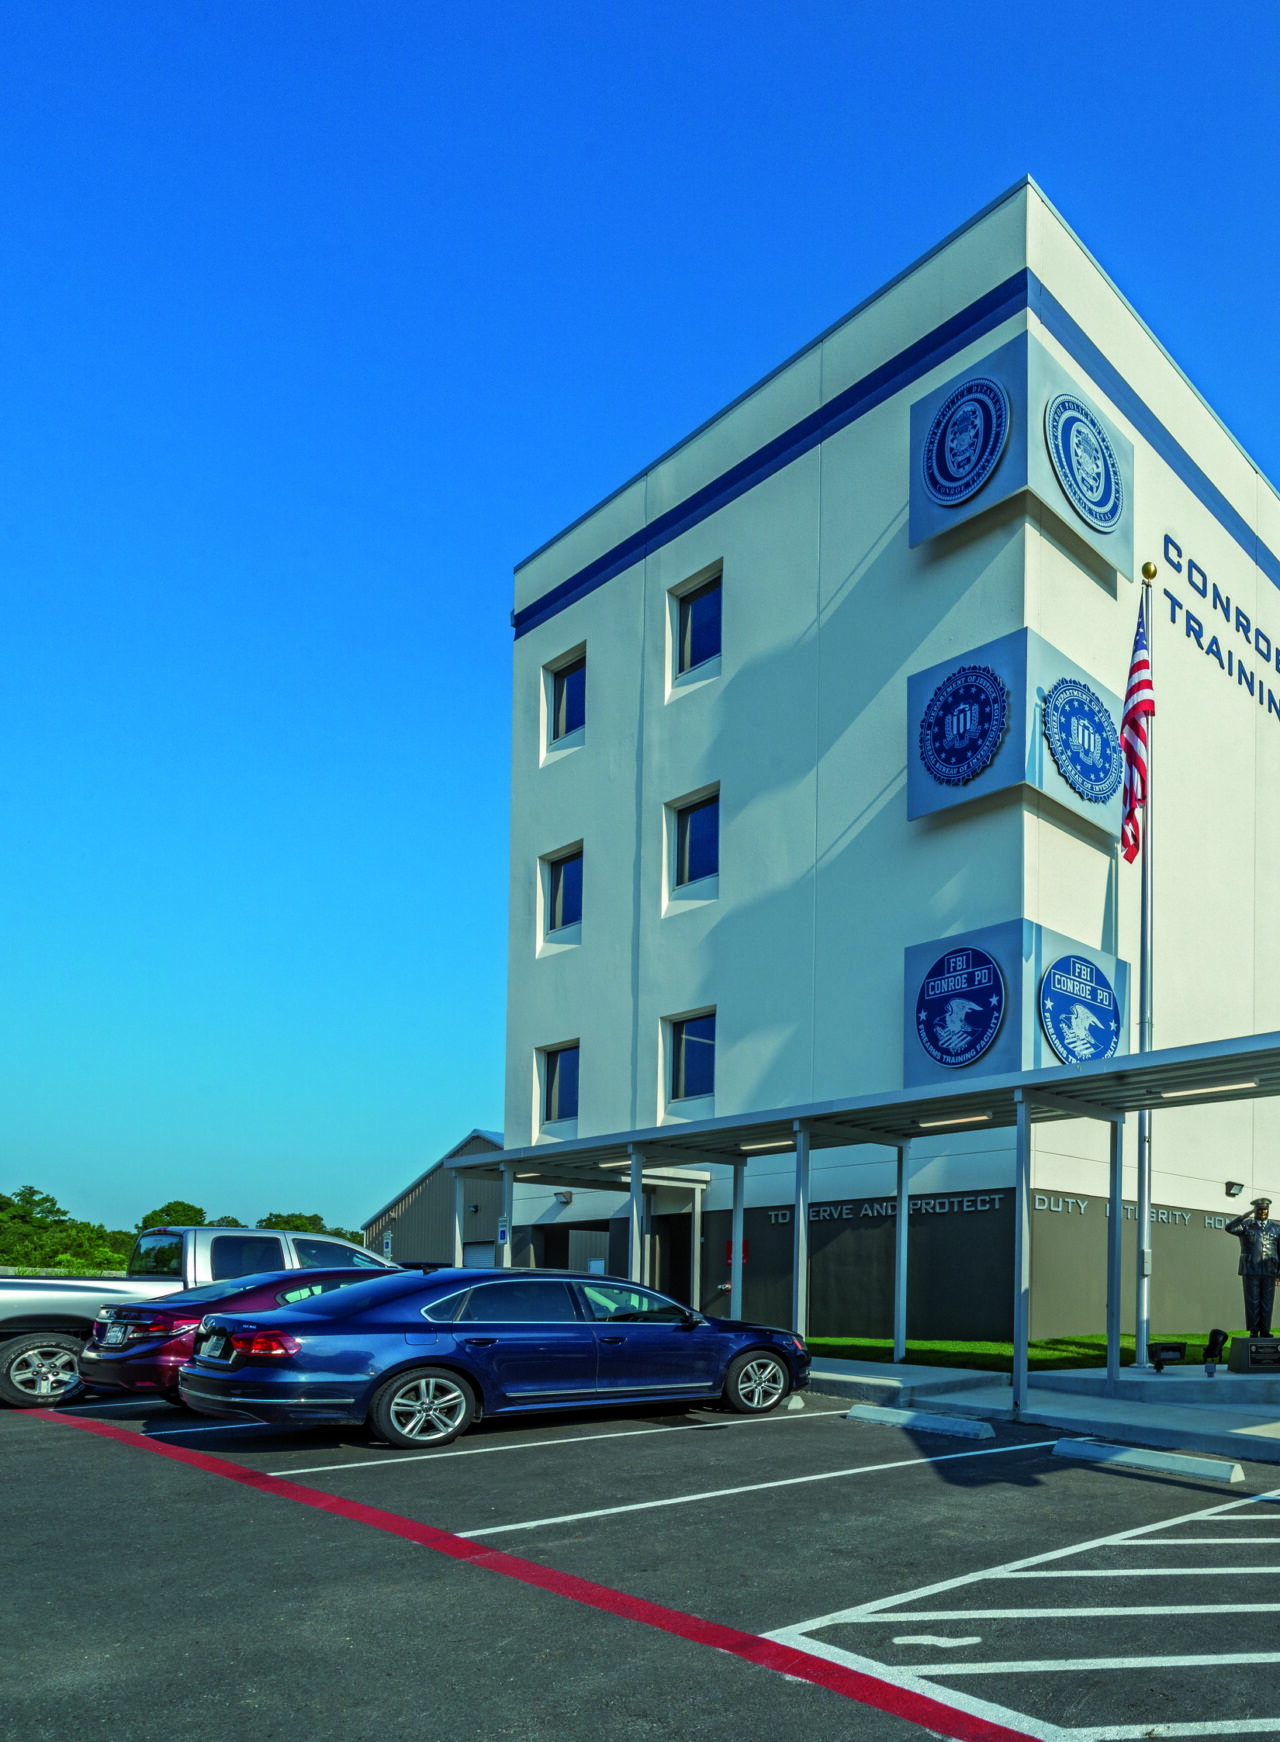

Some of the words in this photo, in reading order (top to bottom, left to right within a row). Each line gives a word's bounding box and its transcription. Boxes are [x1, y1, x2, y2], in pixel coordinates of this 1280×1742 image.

[940, 388, 968, 421] POLICE
[972, 385, 1002, 432] DEPARTMENT
[1052, 405, 1064, 444] CONROE
[1065, 402, 1092, 422] POLICE
[936, 483, 966, 495] CONROE
[1092, 511, 1112, 522] TEXAS
[930, 678, 966, 722] DEPARTMENT
[967, 675, 976, 683] OF
[976, 676, 997, 699] JUSTICE
[1056, 690, 1090, 707] DEPARTMENT
[1091, 700, 1099, 712] OF
[1099, 712, 1115, 747] JUSTICE
[925, 730, 936, 766] FEDERAL
[936, 761, 958, 774] BUREAU
[959, 765, 968, 774] OF
[970, 703, 999, 766] INVESTIGATION
[1052, 711, 1063, 754] FEDERAL
[1061, 755, 1083, 784] BUREAU
[1084, 782, 1092, 790] OF
[1093, 754, 1119, 792] INVESTIGATION
[928, 974, 968, 995] CONROE
[974, 969, 989, 985] PD
[950, 958, 967, 972] FBI
[1075, 963, 1091, 980] FBI
[1054, 974, 1092, 1000] CONROE
[1097, 989, 1109, 1006] PD
[918, 1024, 941, 1062] FIREARMS
[942, 1050, 977, 1064] TRAINING
[976, 1011, 1000, 1051] FACILITY
[1044, 1012, 1068, 1058] FIREARMS
[1102, 1035, 1118, 1059] CILITY
[768, 1210, 790, 1224] TO
[809, 1205, 853, 1222] ERVE
[860, 1202, 897, 1217] AND
[908, 1194, 1004, 1214] PROTECT
[1034, 1194, 1089, 1215] DUTY
[1106, 1203, 1192, 1226] ITGRITY
